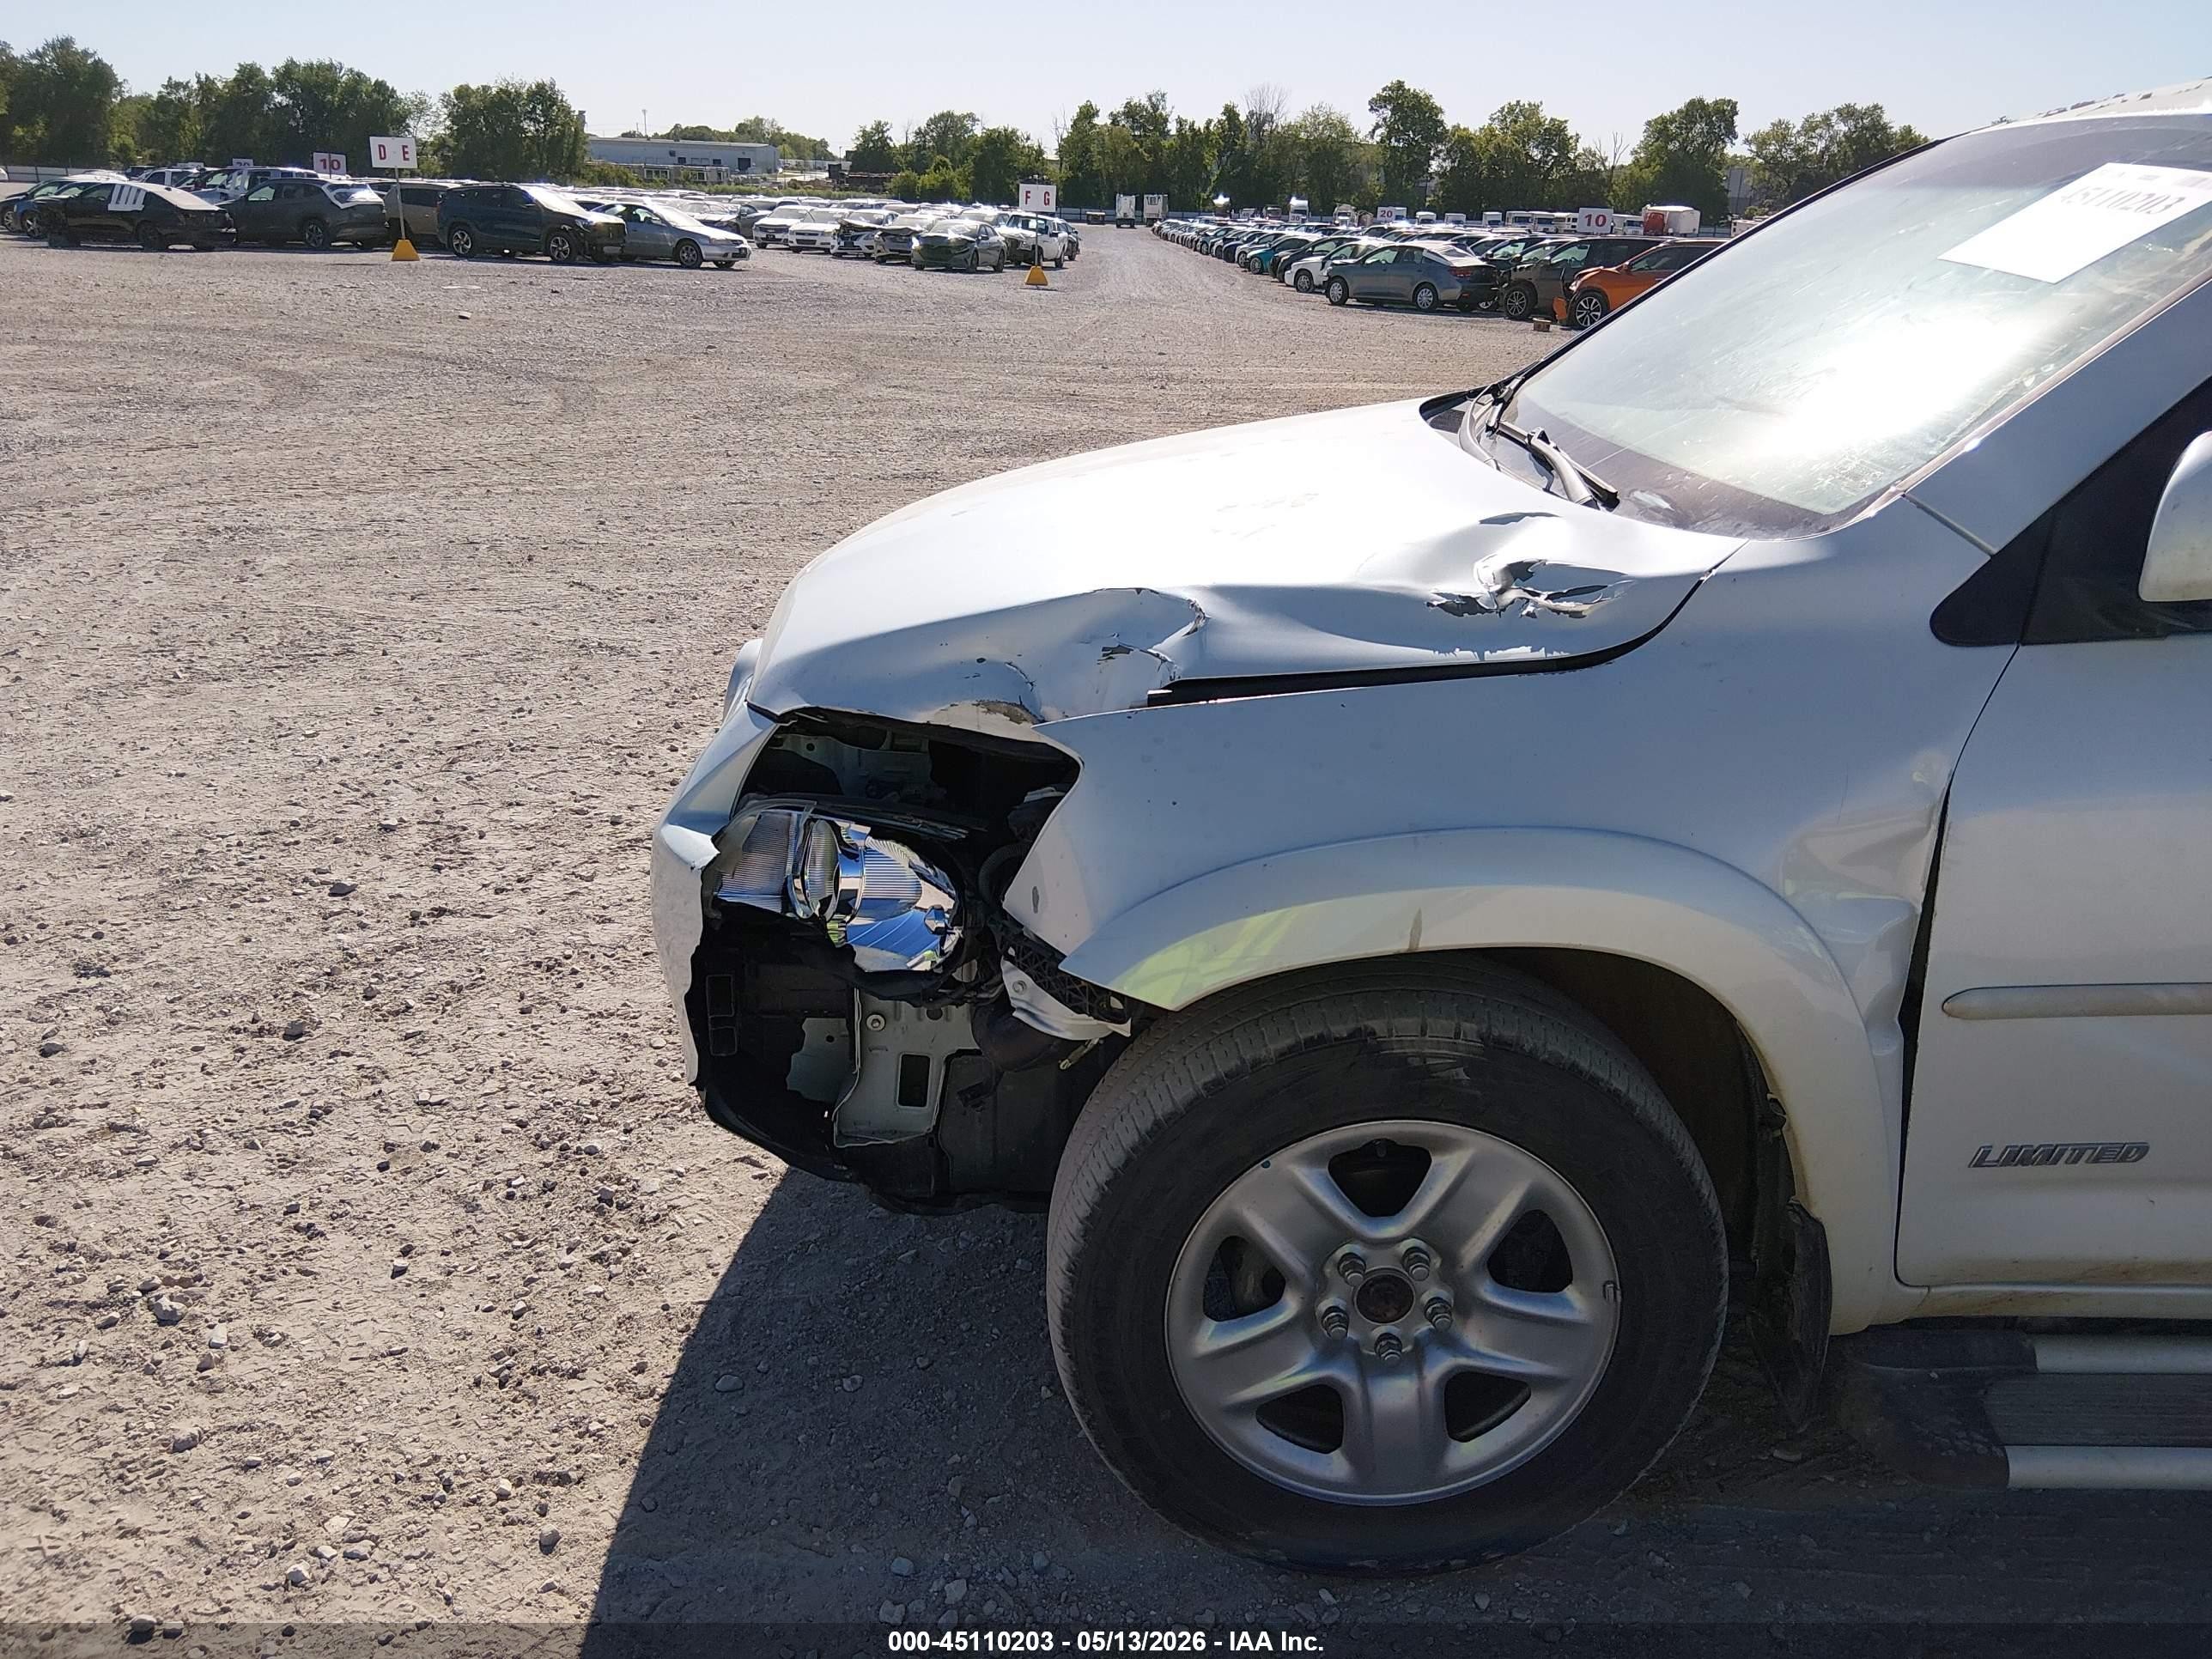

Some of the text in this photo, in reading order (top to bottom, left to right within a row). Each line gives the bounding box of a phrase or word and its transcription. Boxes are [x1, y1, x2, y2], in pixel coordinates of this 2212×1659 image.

[378, 144, 410, 161] D E
[319, 158, 341, 171] 10
[1024, 190, 1050, 206] F G
[1380, 210, 1393, 218] 20
[1584, 214, 1607, 227] 10
[1968, 1141, 2150, 1168] LIMITED
